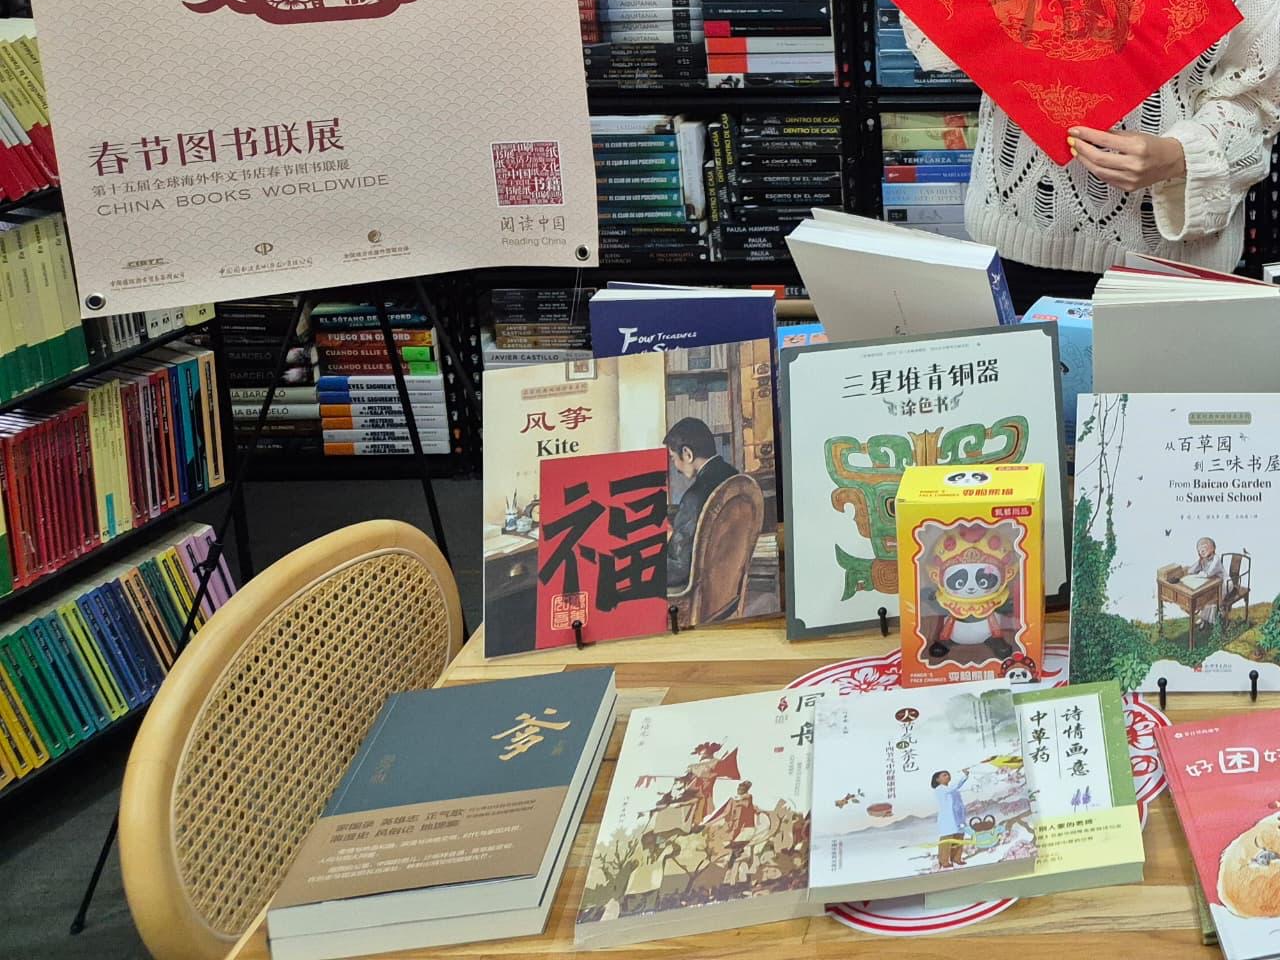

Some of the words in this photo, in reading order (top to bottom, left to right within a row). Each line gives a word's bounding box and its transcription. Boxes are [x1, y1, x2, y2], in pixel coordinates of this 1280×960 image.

[783, 127, 811, 135] DENTRO
[811, 127, 821, 135] DE
[821, 127, 838, 135] CASA
[88, 116, 345, 178] 春节图书联展
[903, 156, 952, 165] TEMPLANZA
[91, 159, 351, 198] 第十五届全球海外华文书店春节图书联展
[97, 196, 166, 218] CHINA
[175, 187, 252, 209] BOOKS
[261, 173, 390, 199] WORLDWIDE
[500, 213, 568, 234] 阅读中国
[501, 236, 534, 248] Reading
[537, 236, 568, 247] China
[618, 327, 657, 354] Four
[490, 353, 519, 362] JAVIER
[520, 352, 560, 362] CASTILLO
[841, 357, 1000, 399] 三星堆青铜器
[901, 395, 950, 417] 涂色书
[519, 405, 593, 435] 风筝
[536, 437, 580, 458] Kite
[1165, 433, 1233, 455] 从百草园
[1168, 479, 1192, 489] From
[1192, 478, 1229, 489] Baicao
[1231, 478, 1273, 489] Garden
[1175, 494, 1185, 503] to
[1185, 492, 1225, 504] Sanwei
[1226, 492, 1263, 503] School
[539, 469, 668, 612] 福
[1027, 709, 1051, 764] 中草药
[1060, 704, 1091, 778] 诗情画意
